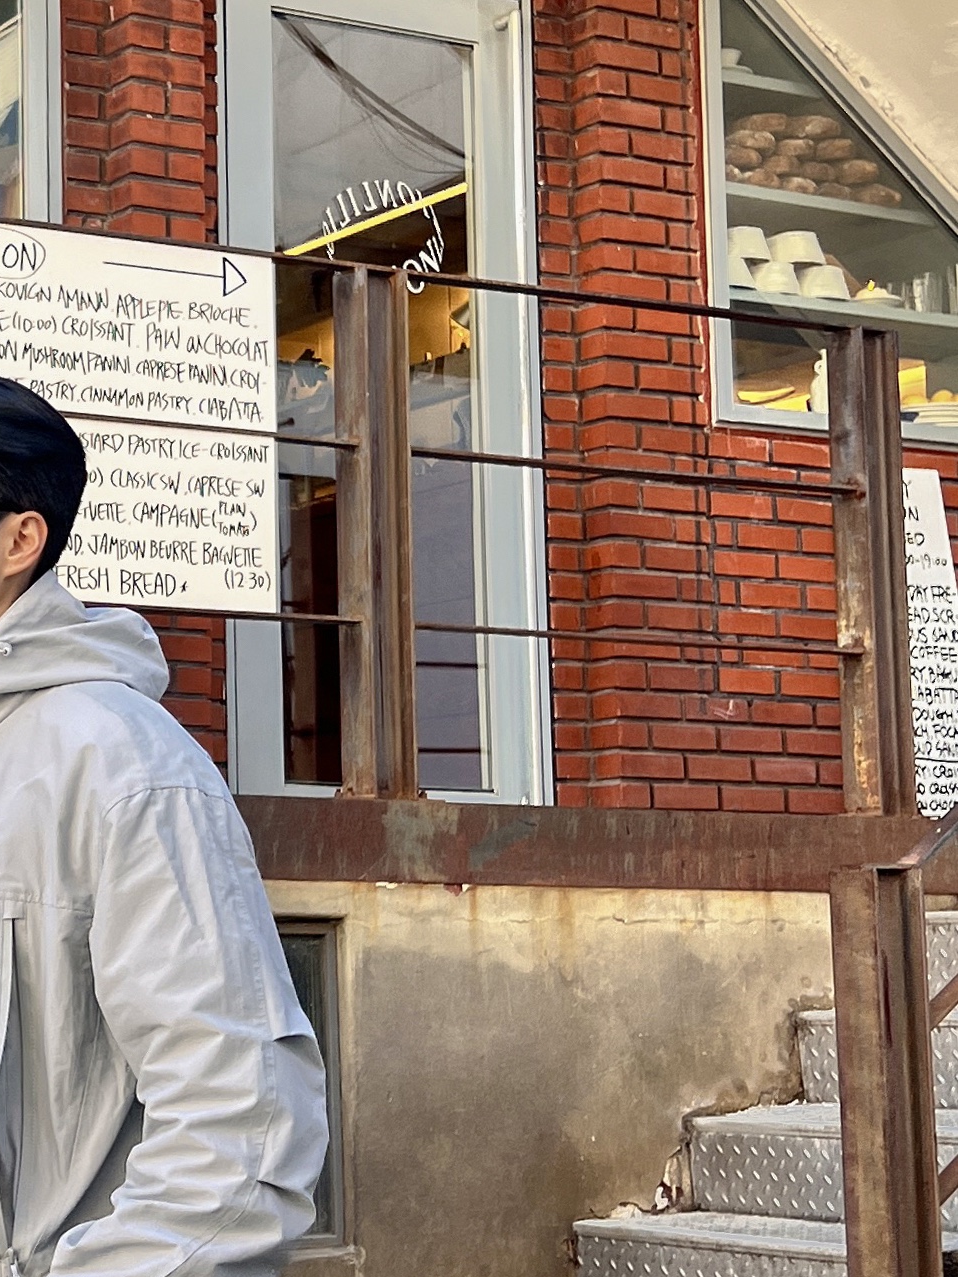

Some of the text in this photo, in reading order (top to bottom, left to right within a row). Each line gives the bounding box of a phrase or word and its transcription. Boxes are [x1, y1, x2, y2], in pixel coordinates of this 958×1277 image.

[22, 342, 86, 376] MUSHROOM
[81, 385, 144, 409] CINNAMON
[187, 475, 243, 498] CAPRESE
[245, 478, 266, 498] SW
[87, 532, 146, 562] JAMBON
[149, 538, 199, 567] BEURRE
[55, 564, 110, 593] FRESH
[119, 568, 178, 599] BREAD
